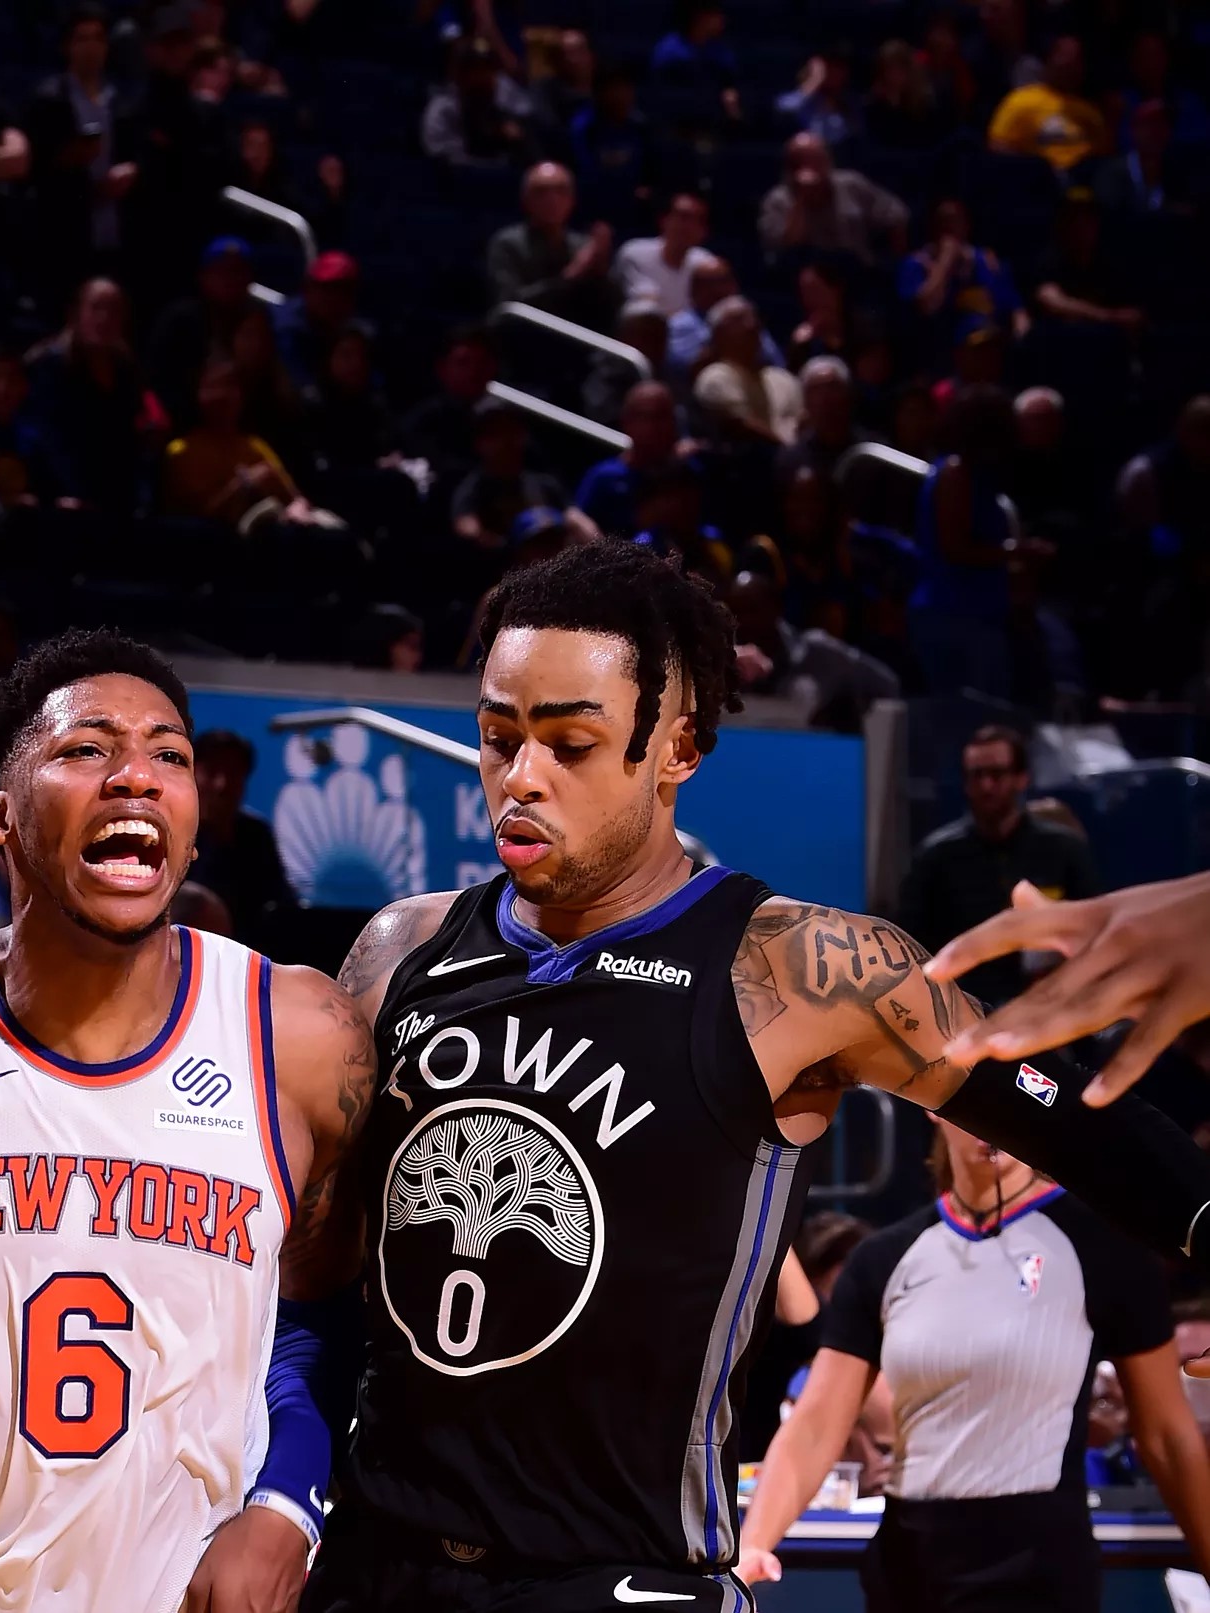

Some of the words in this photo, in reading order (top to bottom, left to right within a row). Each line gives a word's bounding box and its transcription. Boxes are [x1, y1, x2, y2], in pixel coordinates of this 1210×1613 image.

[596, 952, 692, 987] Rakuten
[392, 1011, 436, 1056] The
[159, 1113, 244, 1130] SQUARESPACE
[81, 1156, 263, 1270] YORK
[437, 1270, 486, 1356] 0
[19, 1272, 134, 1459] 6
